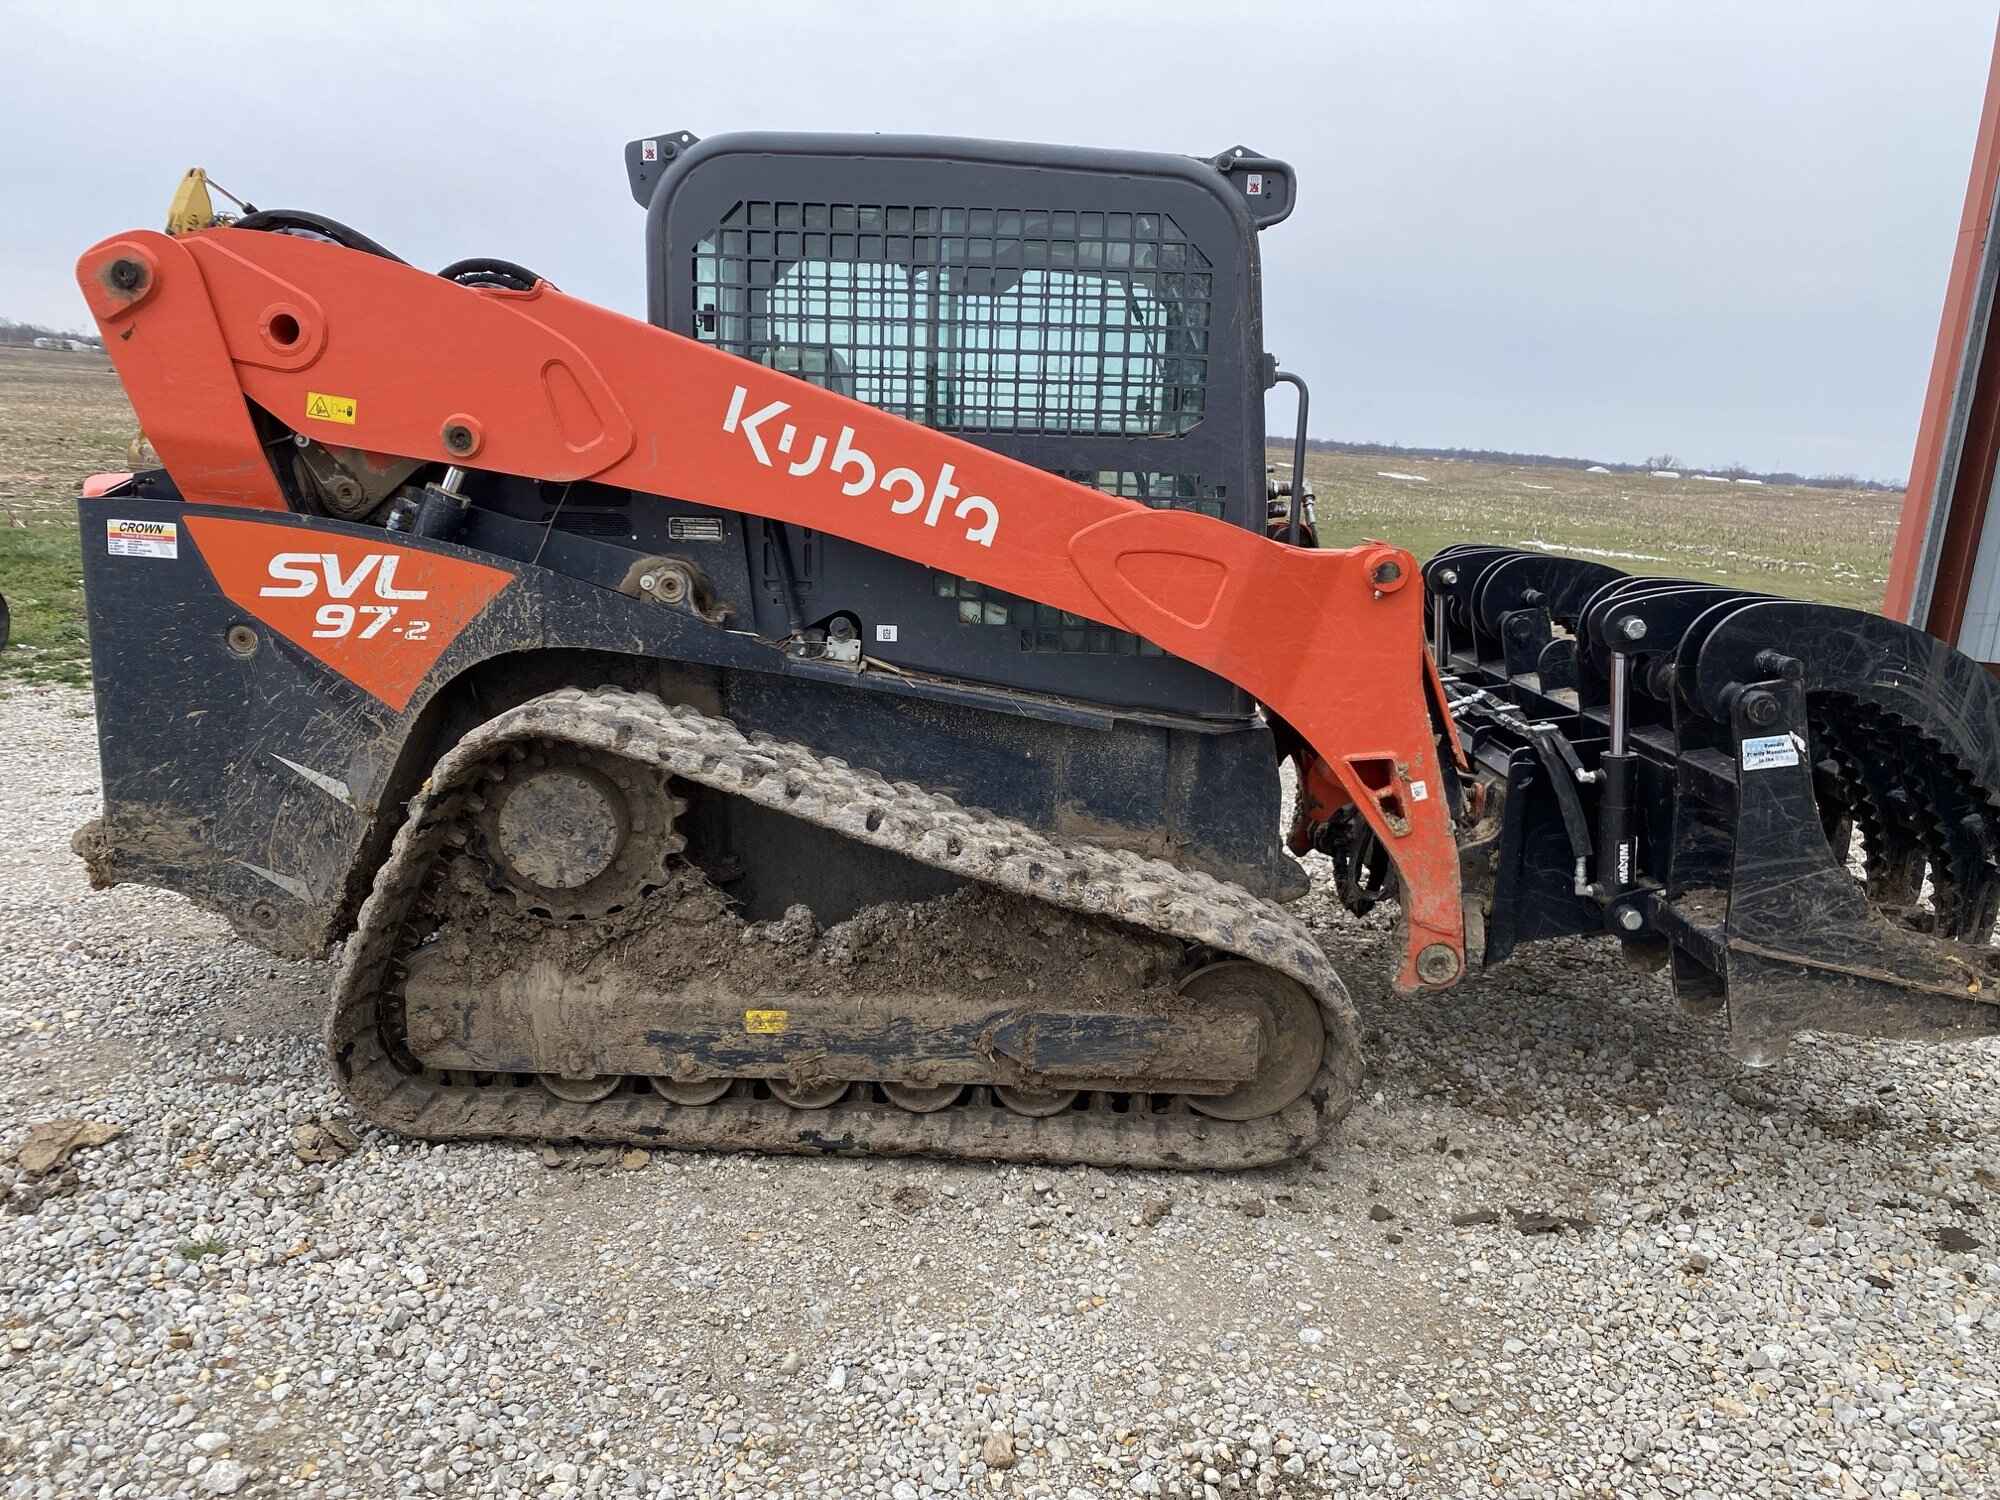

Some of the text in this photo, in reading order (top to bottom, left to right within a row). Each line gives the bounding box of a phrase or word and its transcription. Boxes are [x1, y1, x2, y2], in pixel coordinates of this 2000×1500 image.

[723, 385, 999, 547] Kubota
[120, 522, 164, 534] CROWN
[259, 553, 428, 600] SVL
[312, 604, 431, 640] 97-2
[1617, 844, 1629, 884] MAXIM
